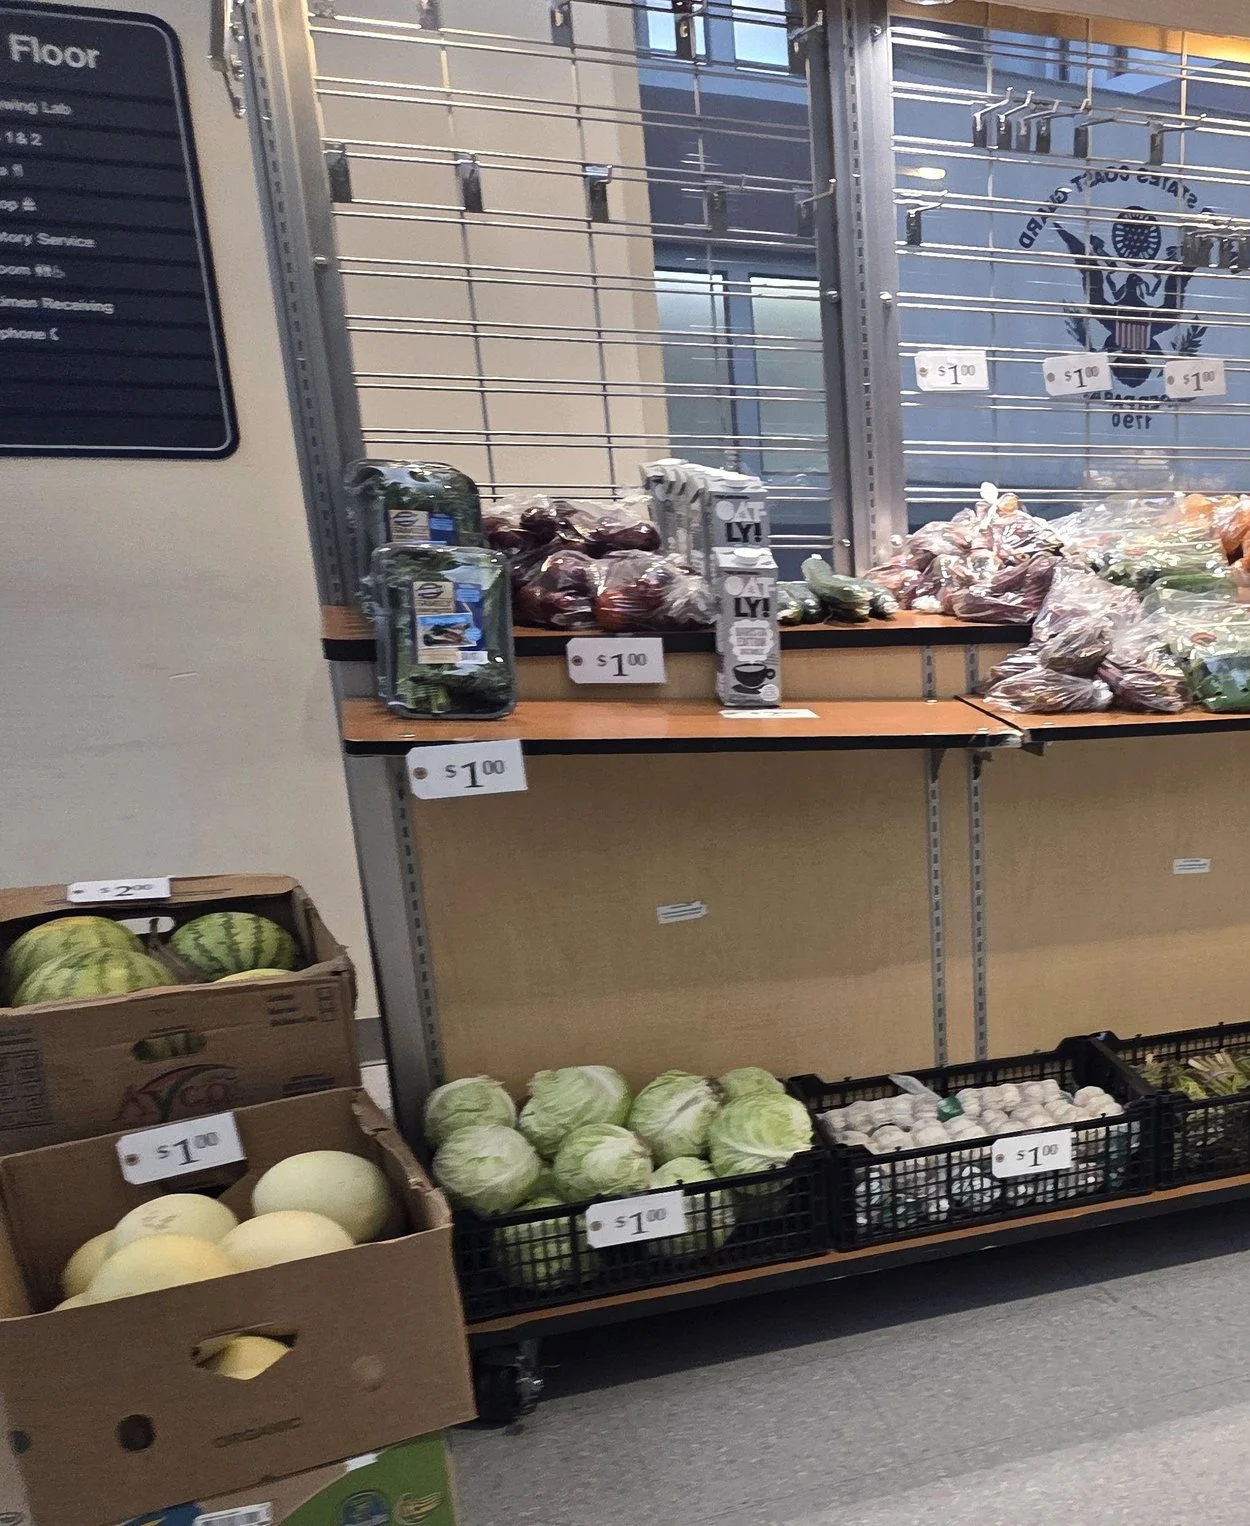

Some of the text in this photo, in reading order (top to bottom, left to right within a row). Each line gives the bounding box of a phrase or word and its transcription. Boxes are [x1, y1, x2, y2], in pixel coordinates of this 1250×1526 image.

[8, 32, 100, 69] Floor
[725, 522, 762, 543] LY!
[734, 597, 770, 618] LY!
